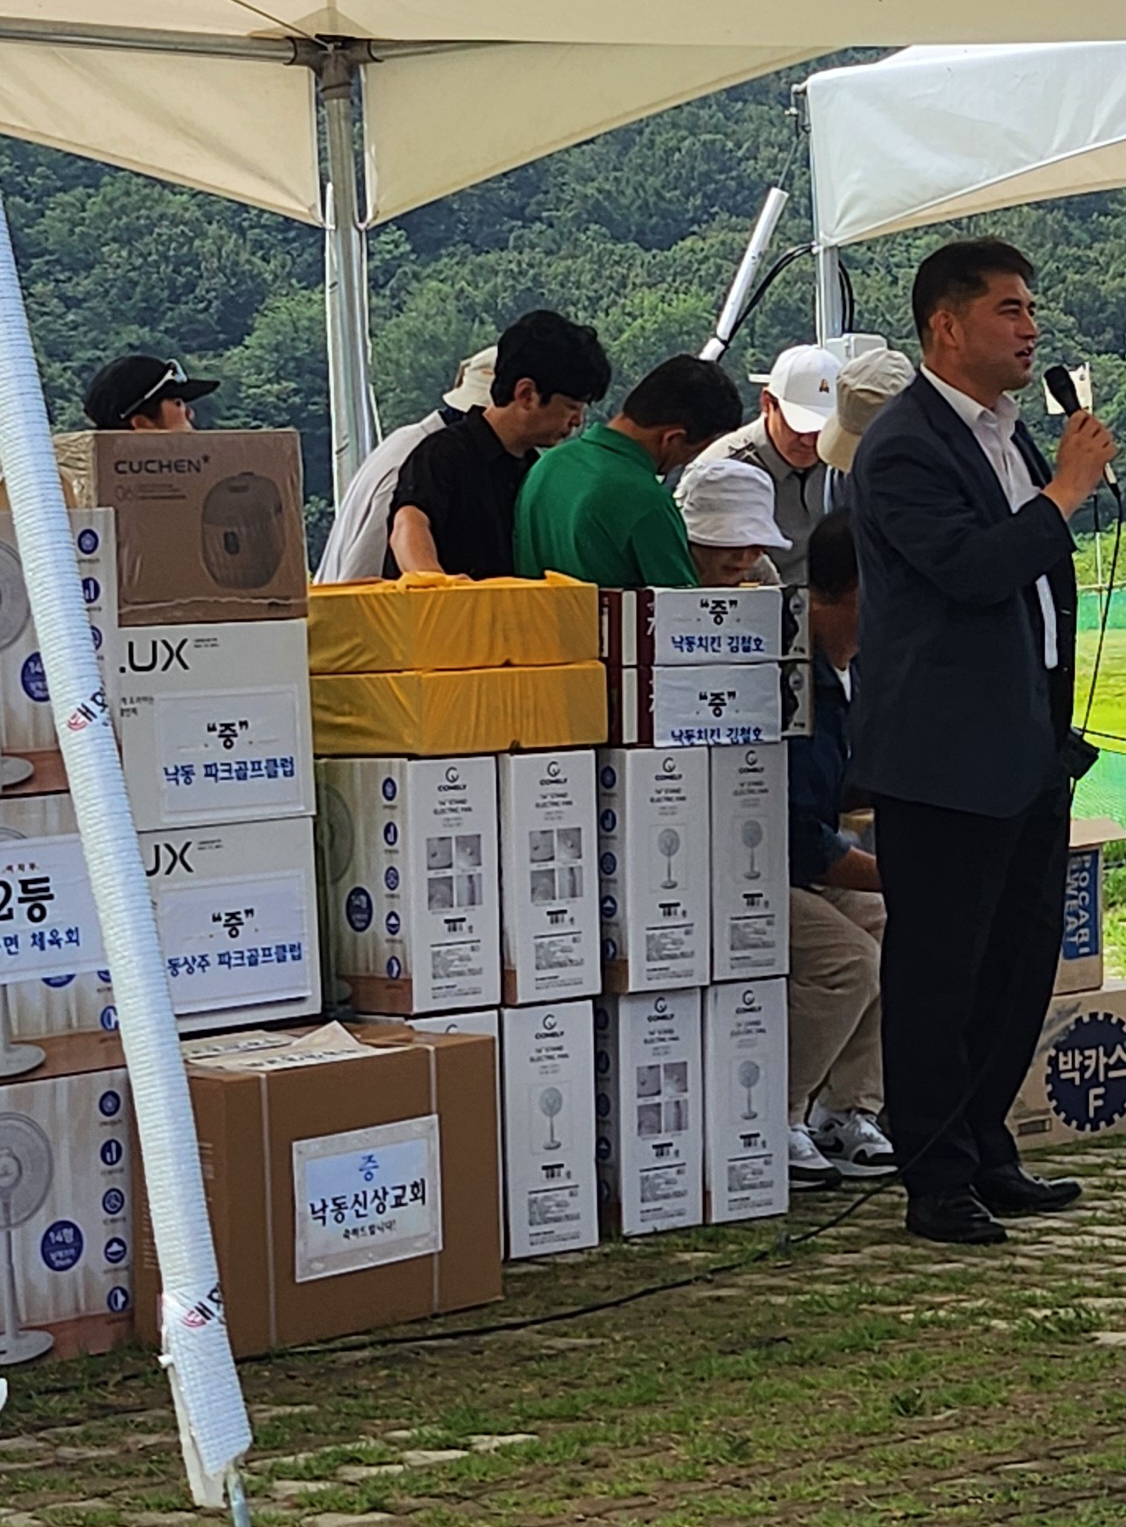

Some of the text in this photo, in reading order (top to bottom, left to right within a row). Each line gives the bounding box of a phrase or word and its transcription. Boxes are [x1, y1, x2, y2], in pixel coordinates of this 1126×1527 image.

[114, 458, 202, 474] CUCHEN
[163, 756, 295, 786] 낙동 파크골프클럽
[0, 876, 55, 924] 2등
[1078, 854, 1092, 954] POCARI
[0, 926, 80, 956] 면 체육회
[217, 942, 303, 970] 파크골프클럽
[1088, 1086, 1105, 1118] F
[358, 1154, 380, 1182] 증
[309, 1177, 427, 1227] 낙동신상교회
